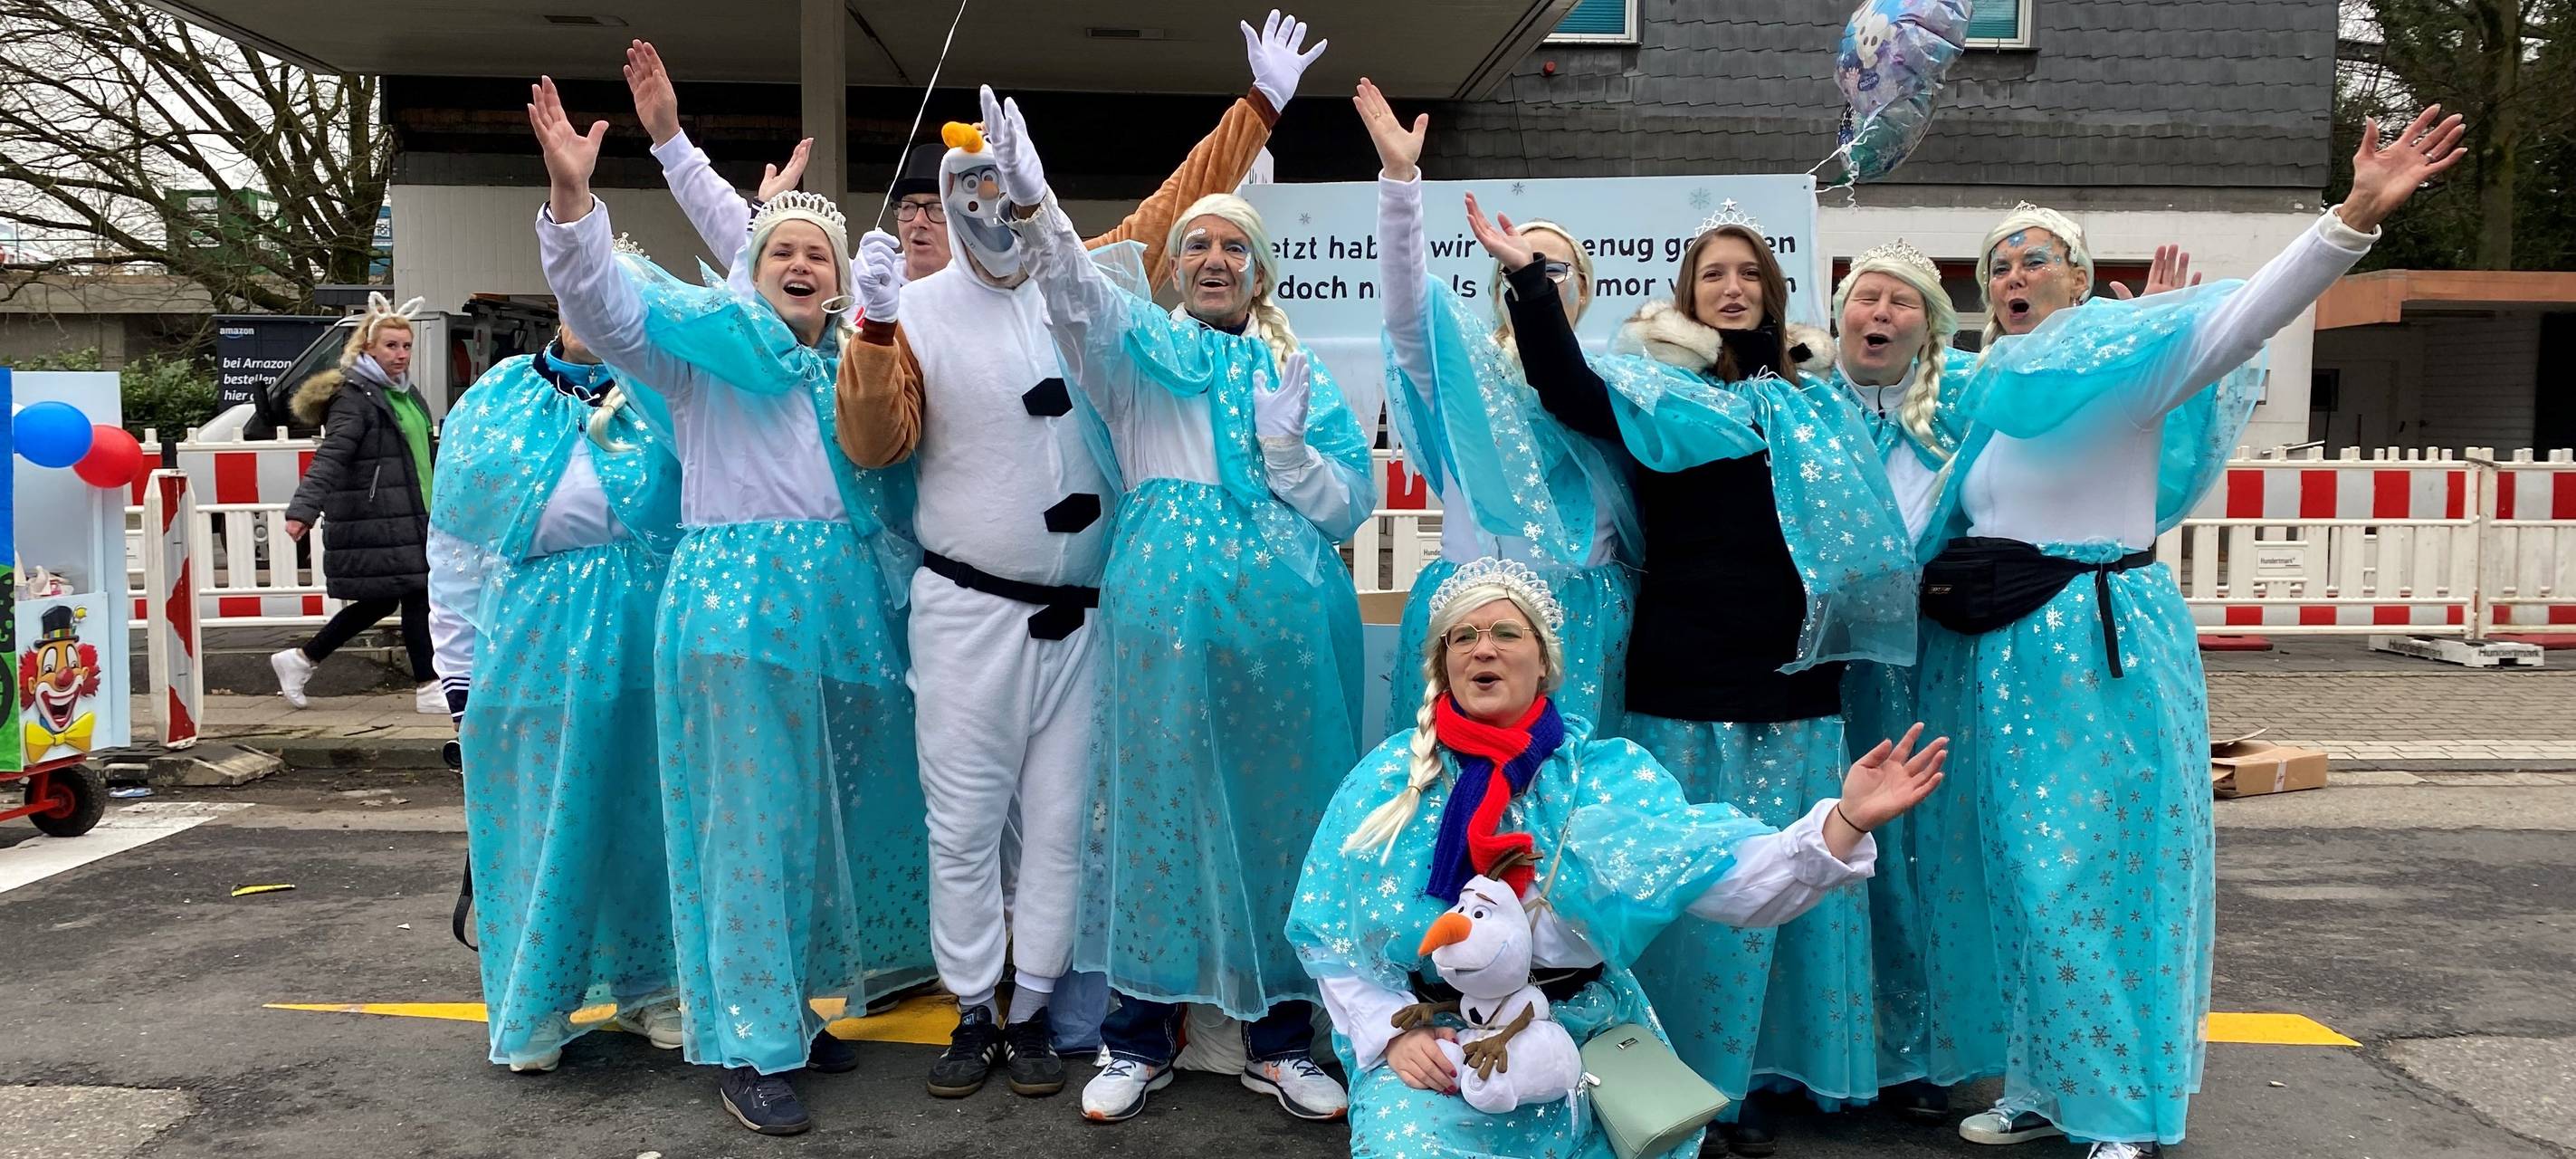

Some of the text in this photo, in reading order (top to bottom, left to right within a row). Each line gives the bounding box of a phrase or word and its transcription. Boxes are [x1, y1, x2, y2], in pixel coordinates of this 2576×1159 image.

[1271, 236, 1317, 259] etzt
[1329, 235, 1378, 259] hab
[1430, 234, 1476, 258] wir
[1582, 238, 1654, 263] enug
[1277, 274, 1347, 299] doch
[1596, 278, 1655, 296] mor
[223, 358, 291, 369] bei Amazon
[224, 374, 277, 385] bestellen
[224, 390, 248, 400] hier
